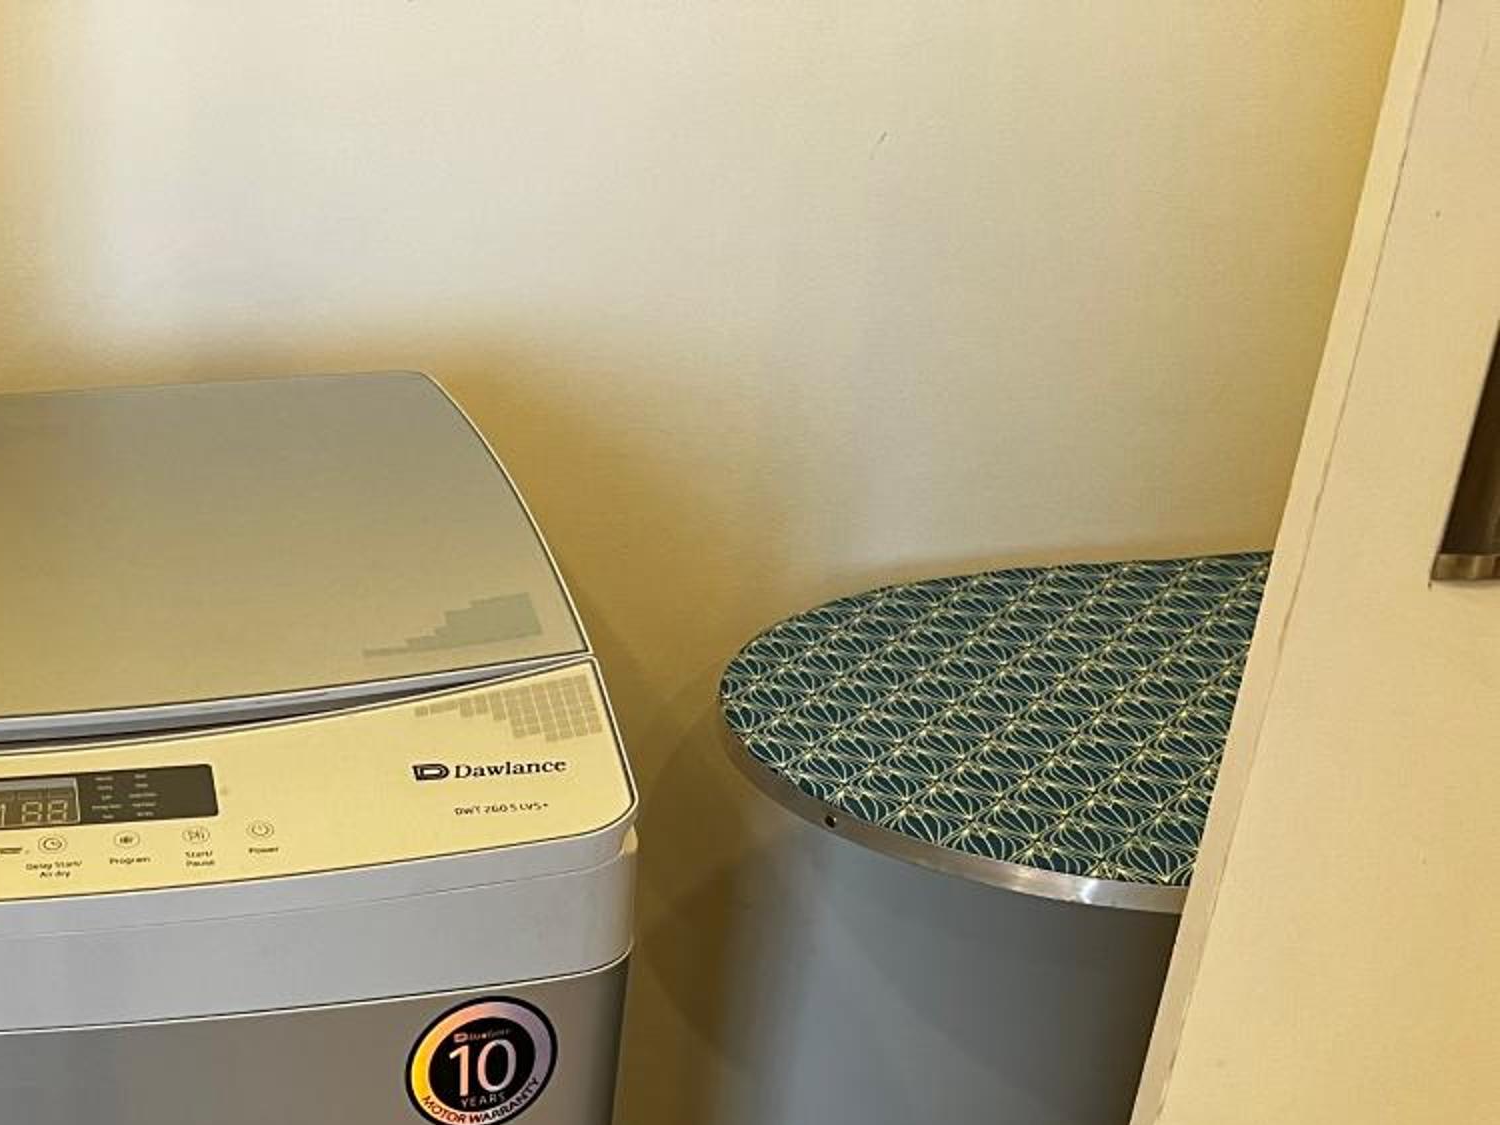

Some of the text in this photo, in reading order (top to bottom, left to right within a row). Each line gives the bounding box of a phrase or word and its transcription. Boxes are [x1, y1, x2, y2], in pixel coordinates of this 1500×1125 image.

[454, 760, 568, 779] Dawlance
[109, 856, 151, 866] Program
[449, 1038, 518, 1098] 10
[421, 1076, 541, 1124] MOTOR WARRANTY
[460, 1092, 506, 1109] YEARS
